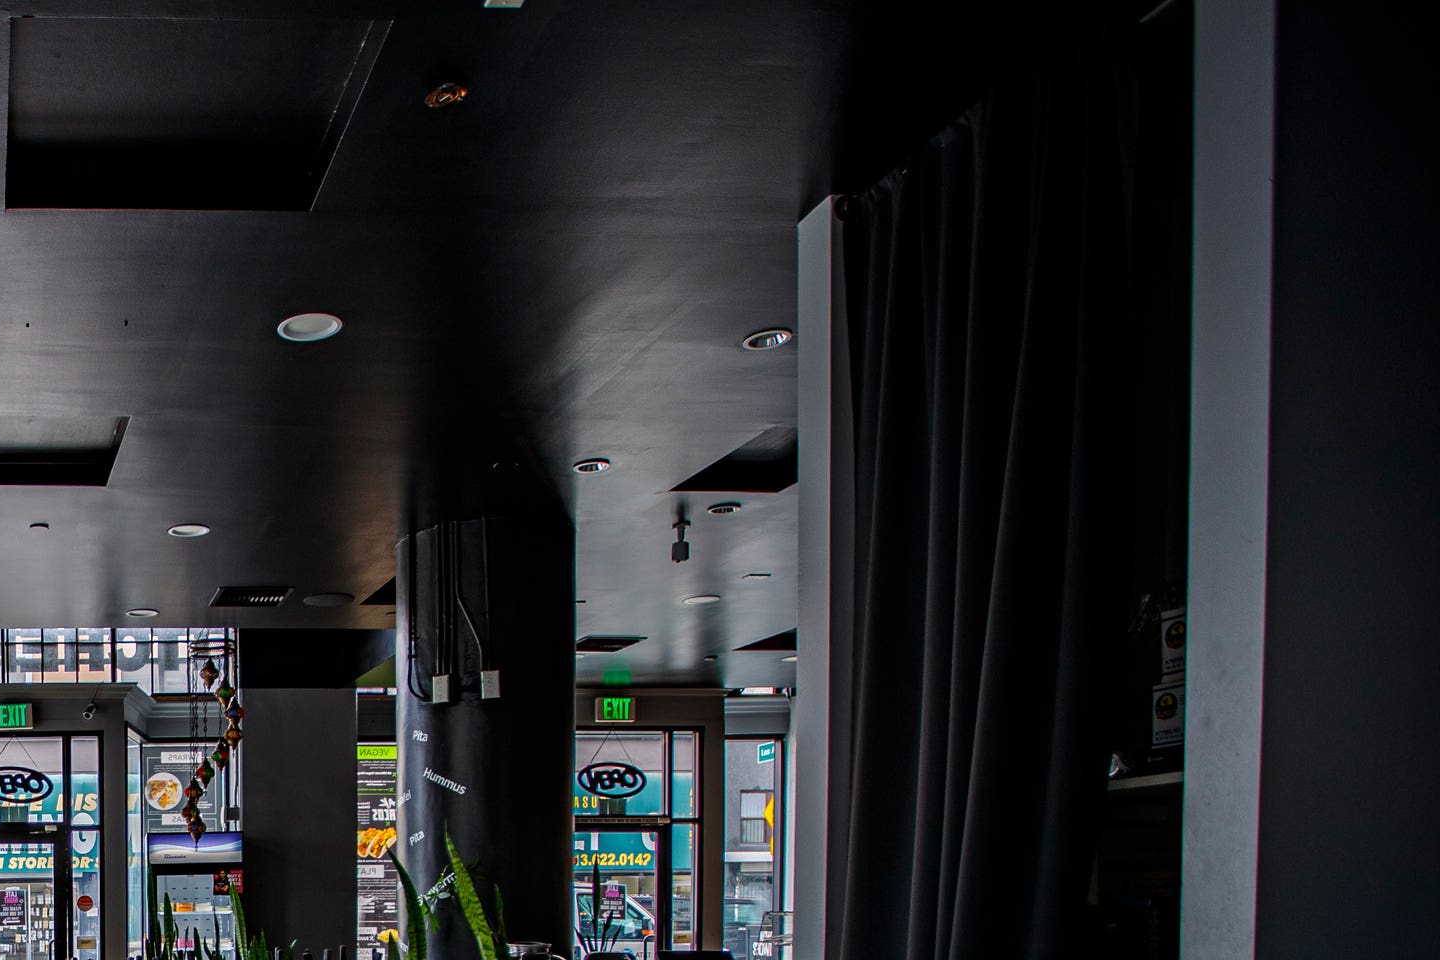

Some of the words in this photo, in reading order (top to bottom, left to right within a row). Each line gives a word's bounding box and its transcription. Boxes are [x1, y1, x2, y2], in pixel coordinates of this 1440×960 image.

[603, 698, 631, 720] EXIT
[412, 730, 429, 742] Pita
[423, 767, 467, 795] Hummus
[409, 829, 425, 847] Pita
